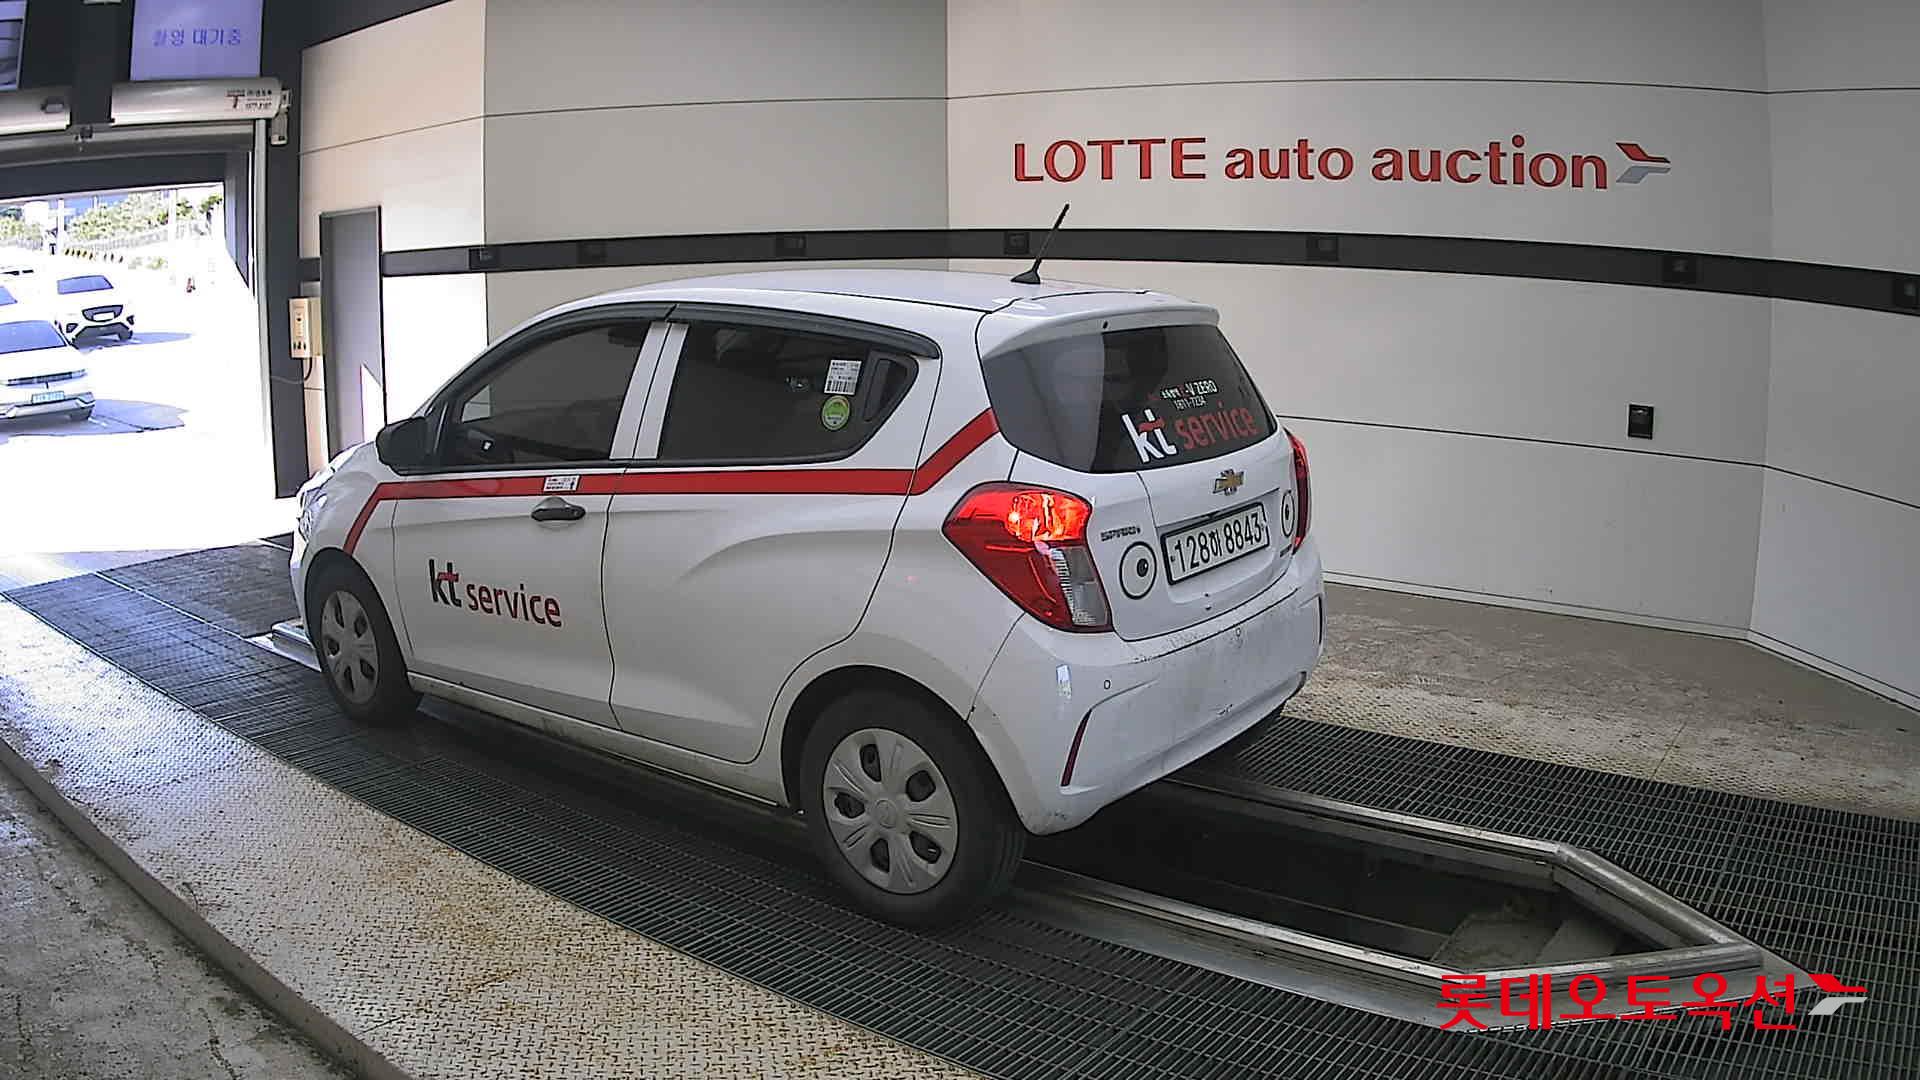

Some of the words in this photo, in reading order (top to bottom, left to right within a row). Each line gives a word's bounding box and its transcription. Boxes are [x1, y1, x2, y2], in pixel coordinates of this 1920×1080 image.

[1014, 137, 1206, 182] LOTTE
[1225, 139, 1353, 180] auto
[1371, 135, 1607, 190] auction
[1122, 408, 1178, 463] kt
[1177, 403, 1257, 450] service
[1224, 512, 1261, 554] 8843
[429, 559, 462, 607] kt
[466, 584, 561, 627] service
